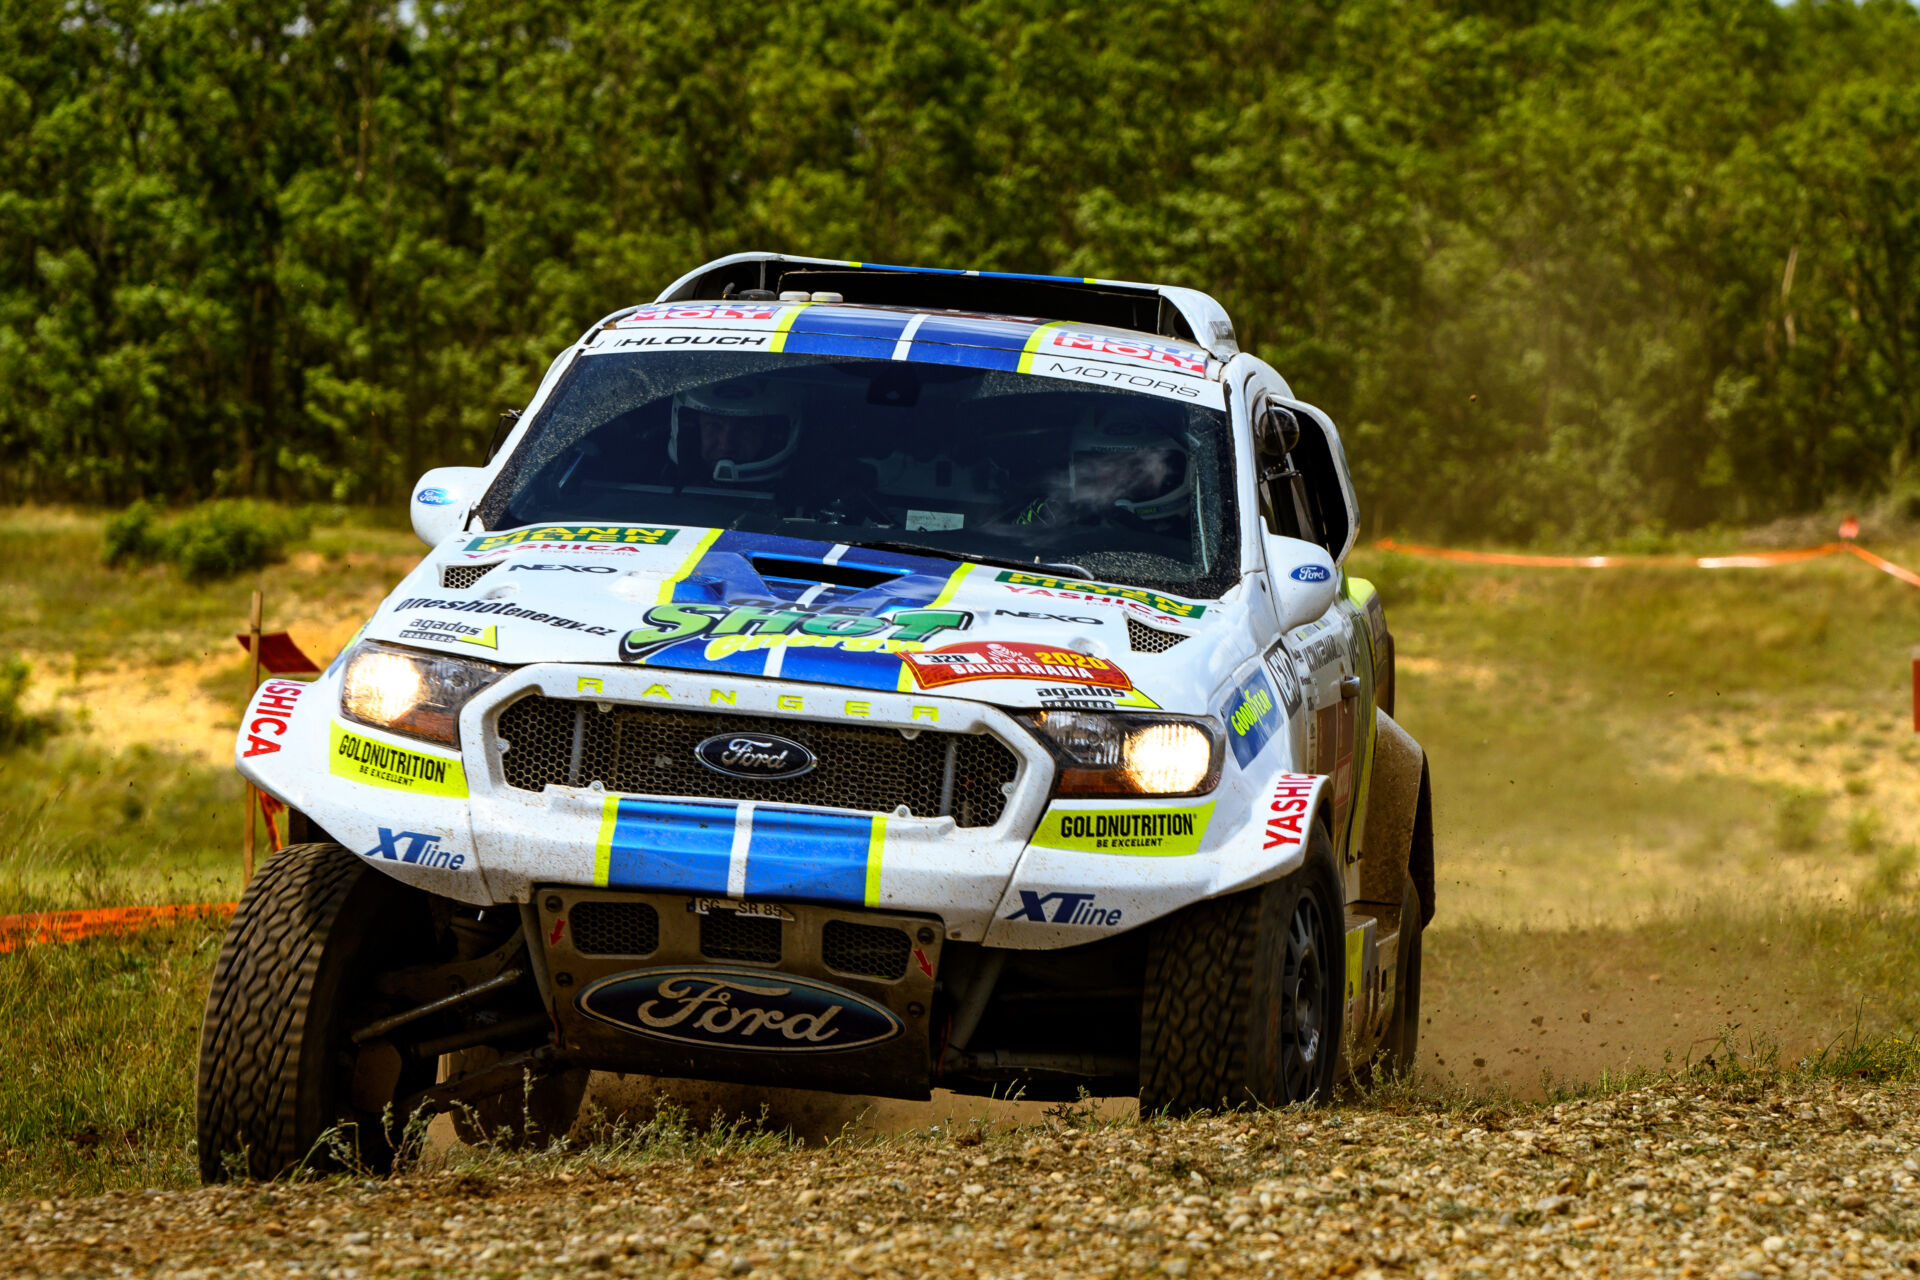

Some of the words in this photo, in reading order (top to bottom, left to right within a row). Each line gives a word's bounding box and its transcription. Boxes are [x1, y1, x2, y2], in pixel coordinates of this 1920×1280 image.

[636, 309, 766, 320] MOLY
[1060, 337, 1204, 371] MOLY
[1049, 362, 1201, 398] MOTORS
[484, 527, 667, 544] MANN
[464, 543, 641, 558] YASHICA
[508, 563, 619, 574] NEXO
[1298, 566, 1325, 581] Ford
[394, 597, 619, 637] oneshotenergy.cz
[727, 597, 875, 617] ONE
[994, 609, 1105, 625] NEXO
[1003, 585, 1182, 624] YASHICA
[409, 618, 484, 636] agados
[618, 603, 974, 662] SHOT
[705, 634, 926, 661] energy
[950, 663, 1015, 675] SAUDI
[1017, 663, 1095, 680] ARABIA
[1034, 651, 1112, 670] 2020
[576, 676, 940, 722] RANGER
[1035, 684, 1126, 700] agados
[243, 679, 308, 758] ASHICA
[338, 734, 446, 784] GOLDNUTRITION
[721, 737, 787, 770] Ford
[360, 765, 369, 776] BE
[370, 768, 415, 787] EXCELLENT
[1263, 773, 1318, 850] YASHIC
[1060, 813, 1194, 838] GOLDNUTRITION
[363, 826, 466, 871] XTline
[1096, 839, 1109, 848] BE
[1111, 838, 1163, 848] EXCELLENT
[738, 901, 759, 915] SR
[1004, 890, 1123, 927] XTline
[636, 974, 845, 1042] Ford
